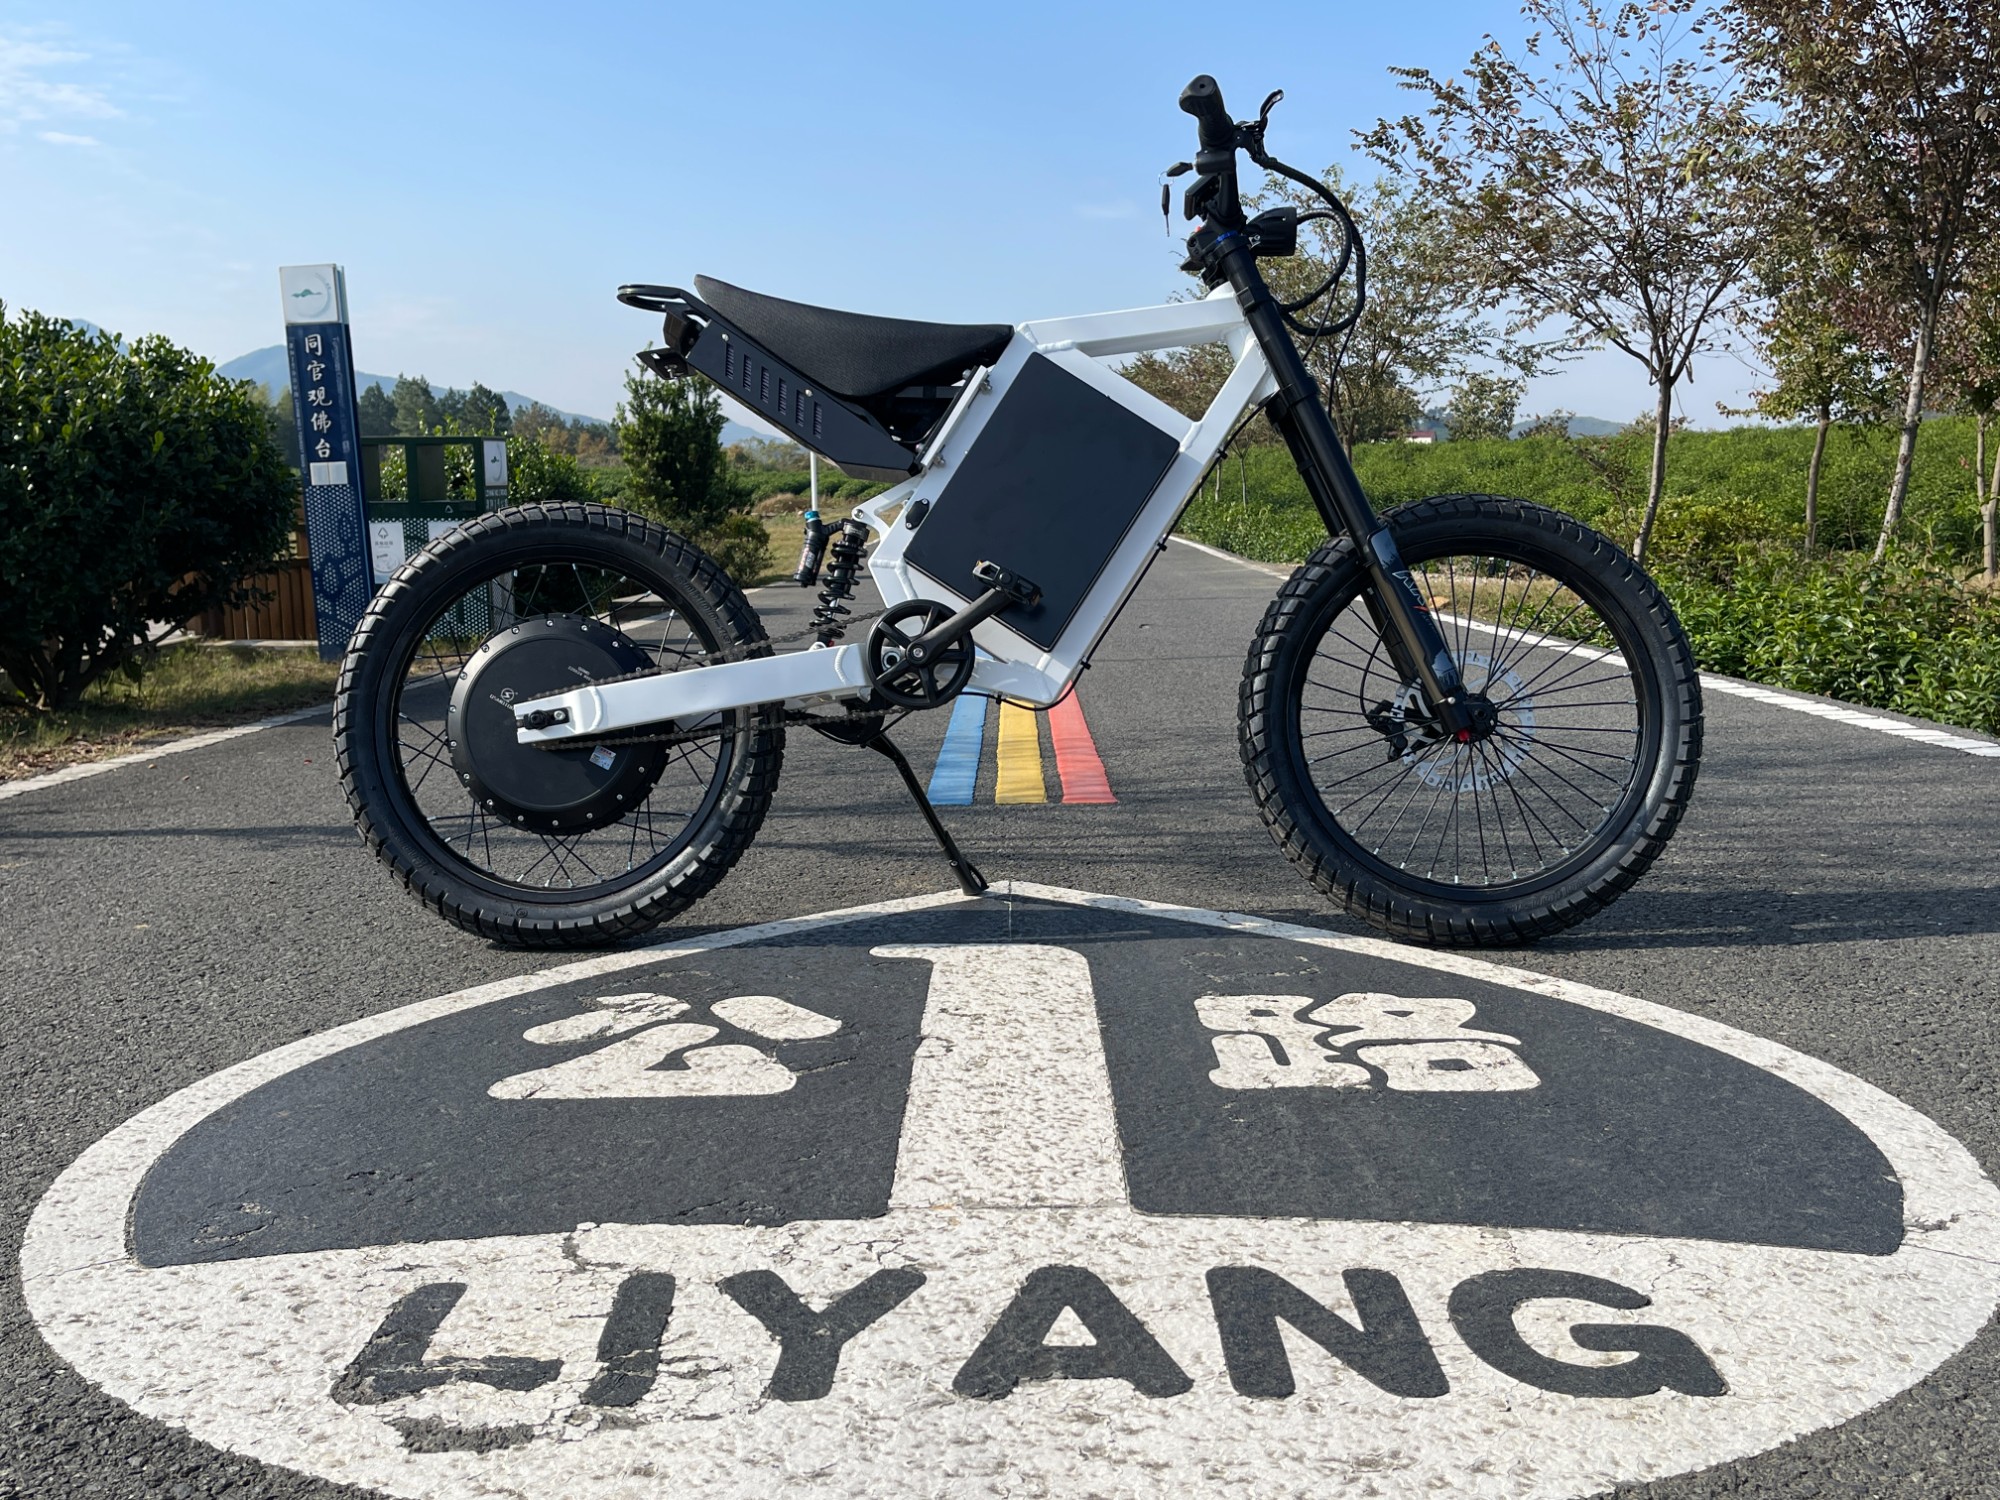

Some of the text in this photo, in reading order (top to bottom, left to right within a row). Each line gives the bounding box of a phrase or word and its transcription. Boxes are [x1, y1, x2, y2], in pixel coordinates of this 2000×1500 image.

[305, 333, 332, 458] 同官观佛台
[486, 992, 843, 1100] 公
[1194, 992, 1541, 1093] 路
[330, 1266, 1732, 1407] LIYANG
